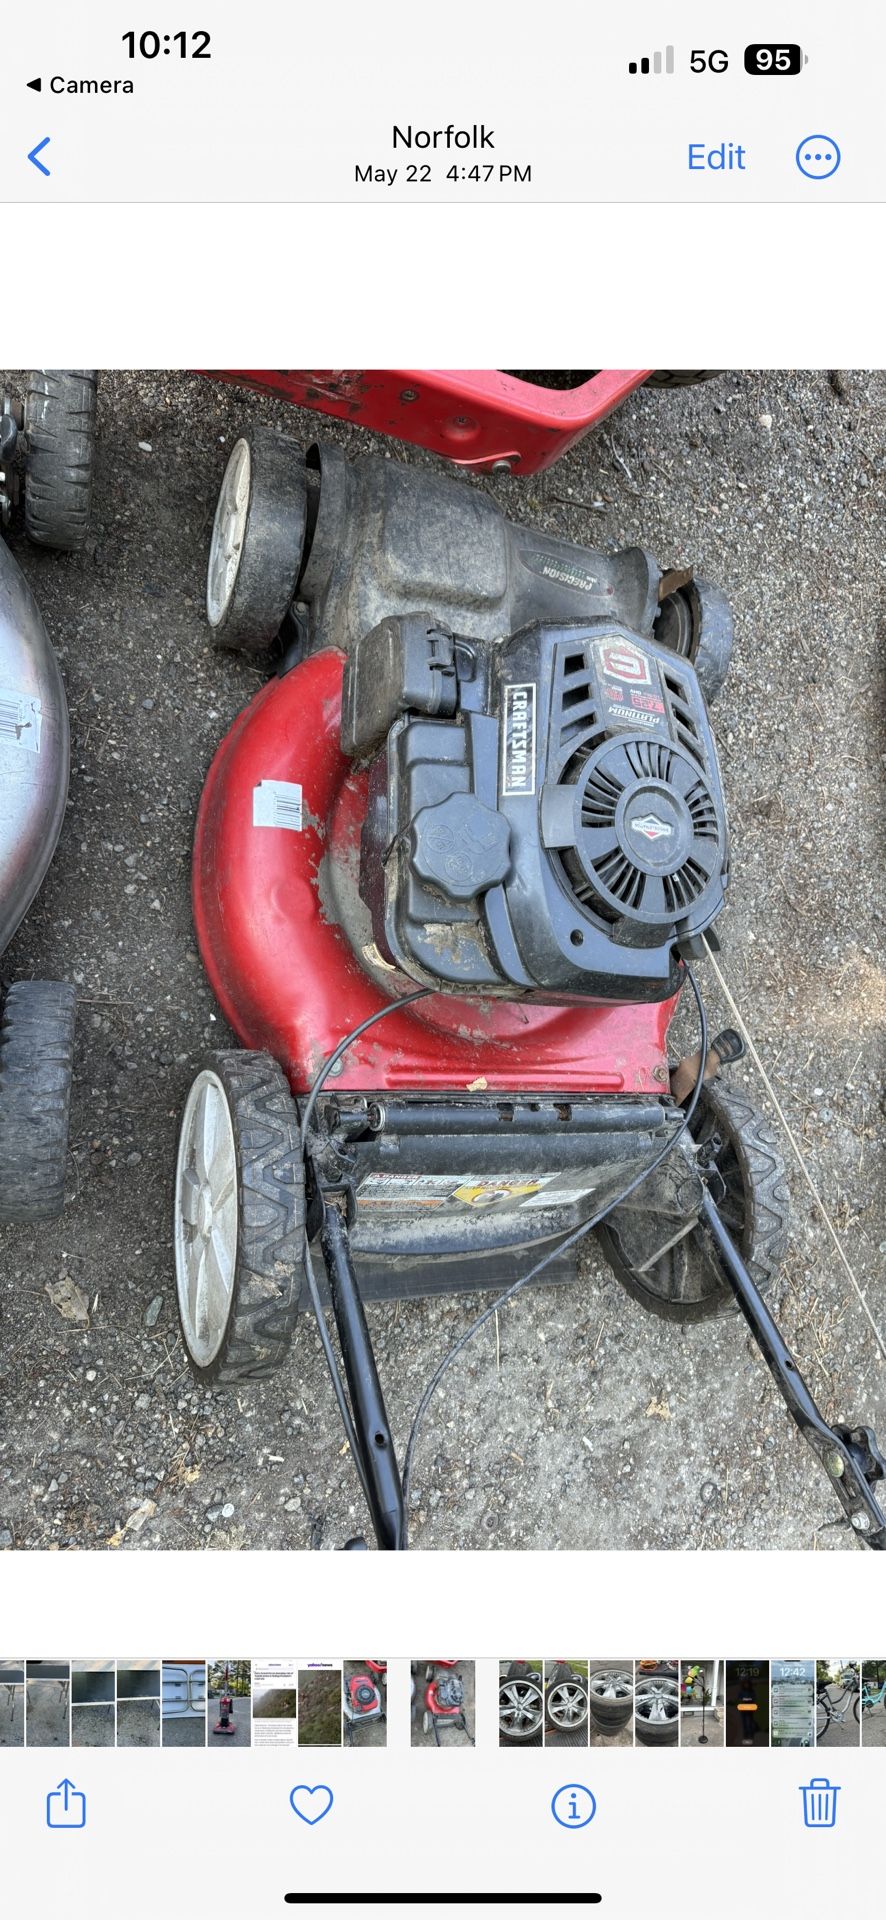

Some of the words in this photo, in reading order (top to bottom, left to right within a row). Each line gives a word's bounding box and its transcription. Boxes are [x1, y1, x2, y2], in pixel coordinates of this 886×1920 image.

[121, 30, 212, 60] 10:12
[689, 49, 729, 74] 5G
[755, 48, 791, 71] 95
[49, 75, 134, 95] Camera
[392, 124, 496, 149] Norfolk
[688, 142, 746, 170] Edit
[354, 164, 398, 187] May
[405, 164, 432, 183] 22
[445, 164, 495, 183] 4:47
[499, 164, 532, 183] PM
[542, 566, 592, 590] PRECISION
[608, 706, 660, 724] PLATINUM
[511, 690, 528, 787] CRAFTSMAN
[736, 1667, 760, 1677] 12:19
[780, 1667, 806, 1677] 12:42
